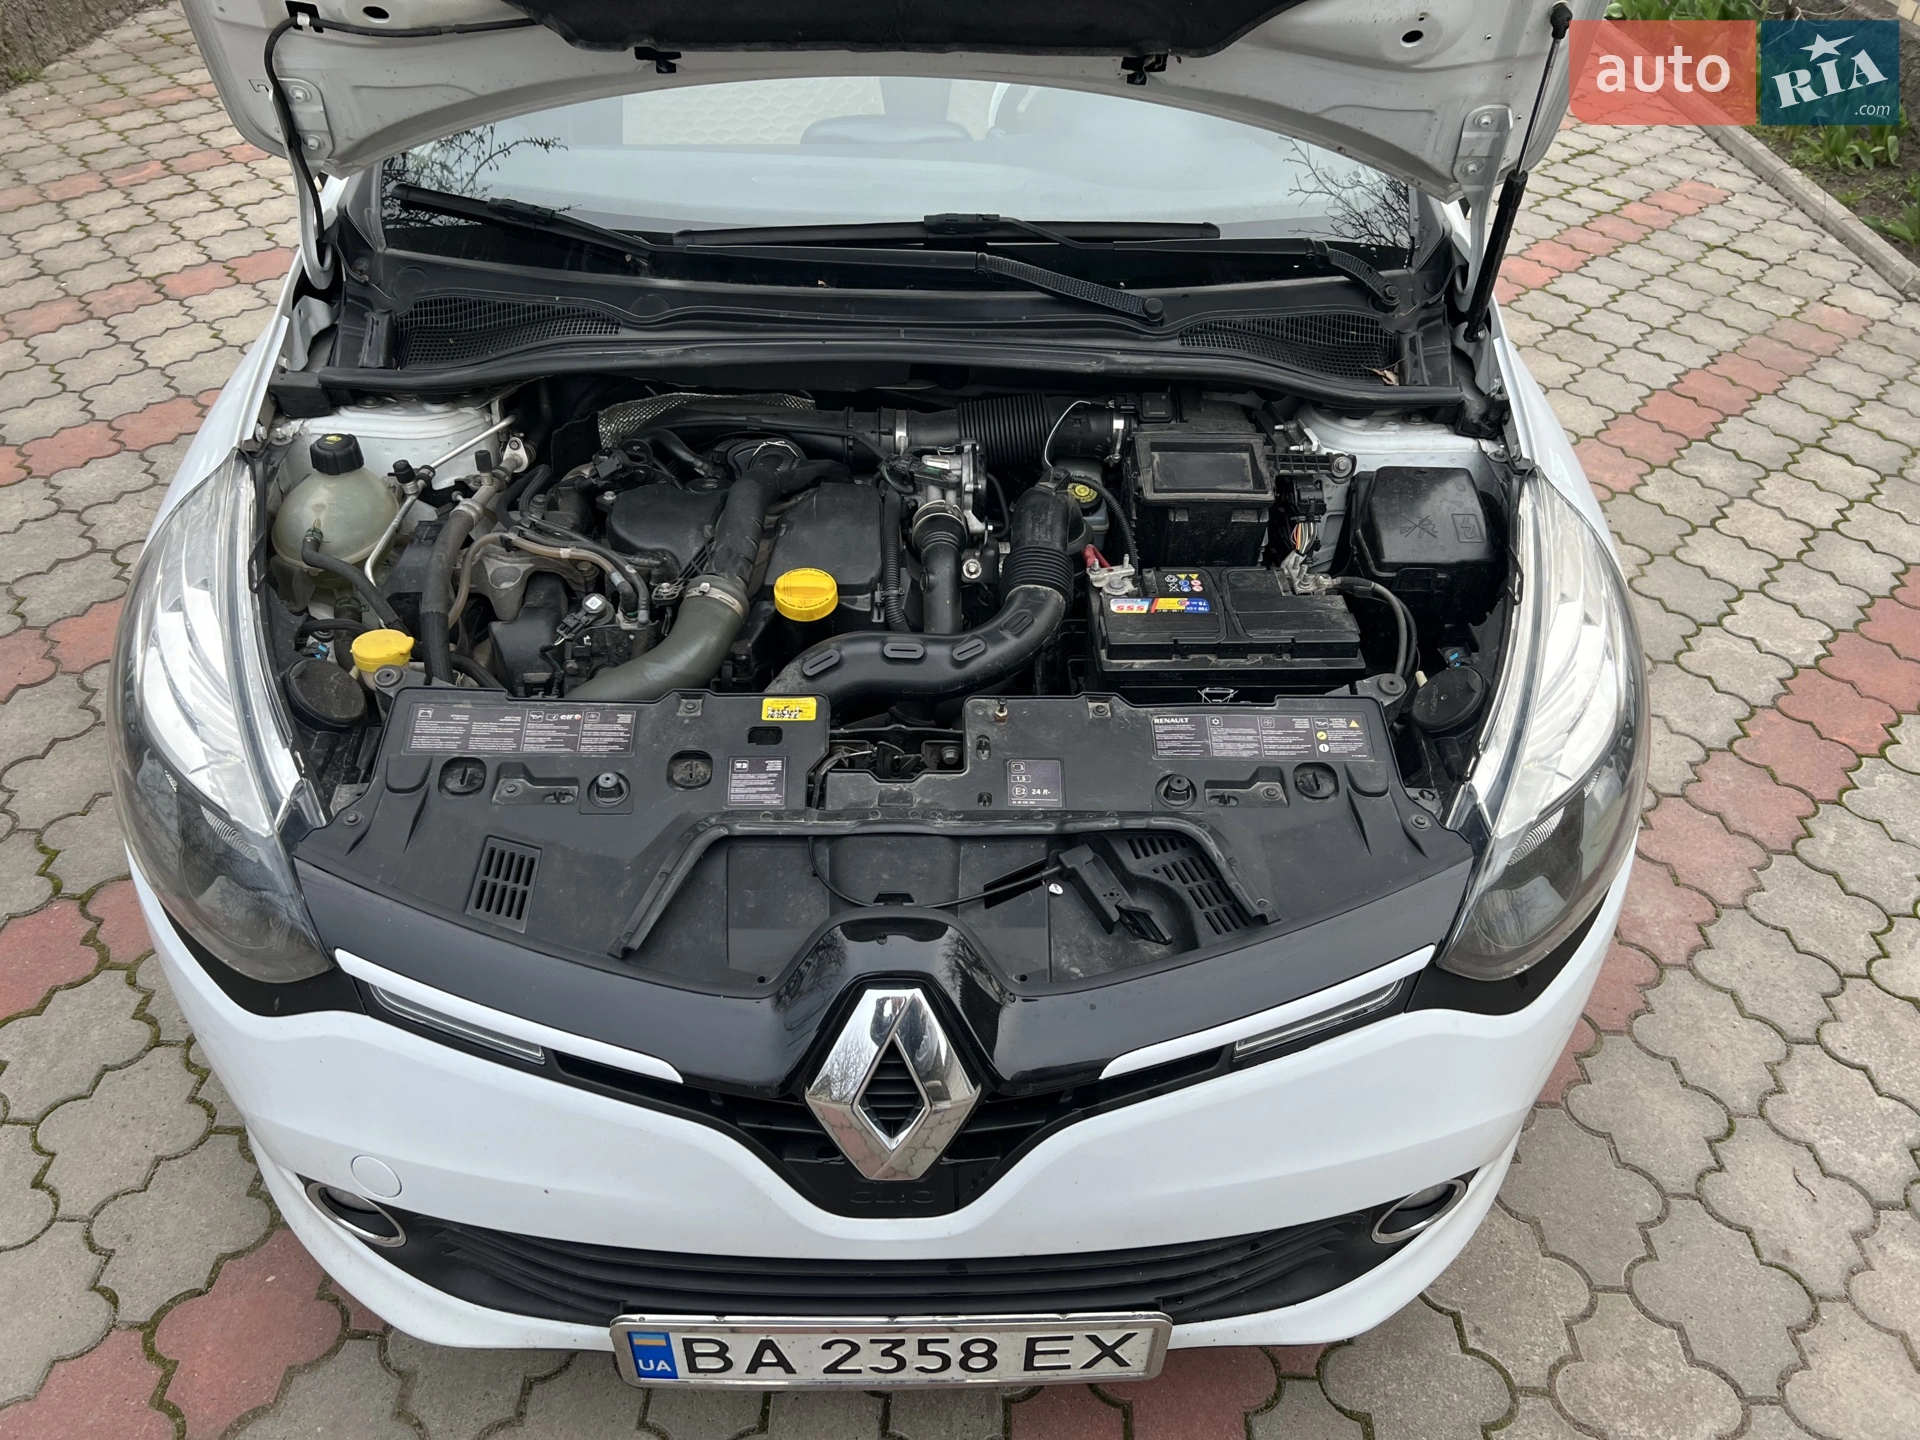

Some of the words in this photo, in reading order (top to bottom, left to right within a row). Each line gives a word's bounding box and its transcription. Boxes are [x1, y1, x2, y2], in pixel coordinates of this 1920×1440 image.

[638, 1358, 672, 1373] UA
[681, 1336, 797, 1375] BA
[820, 1336, 998, 1375] 2358
[1023, 1331, 1139, 1372] EX
